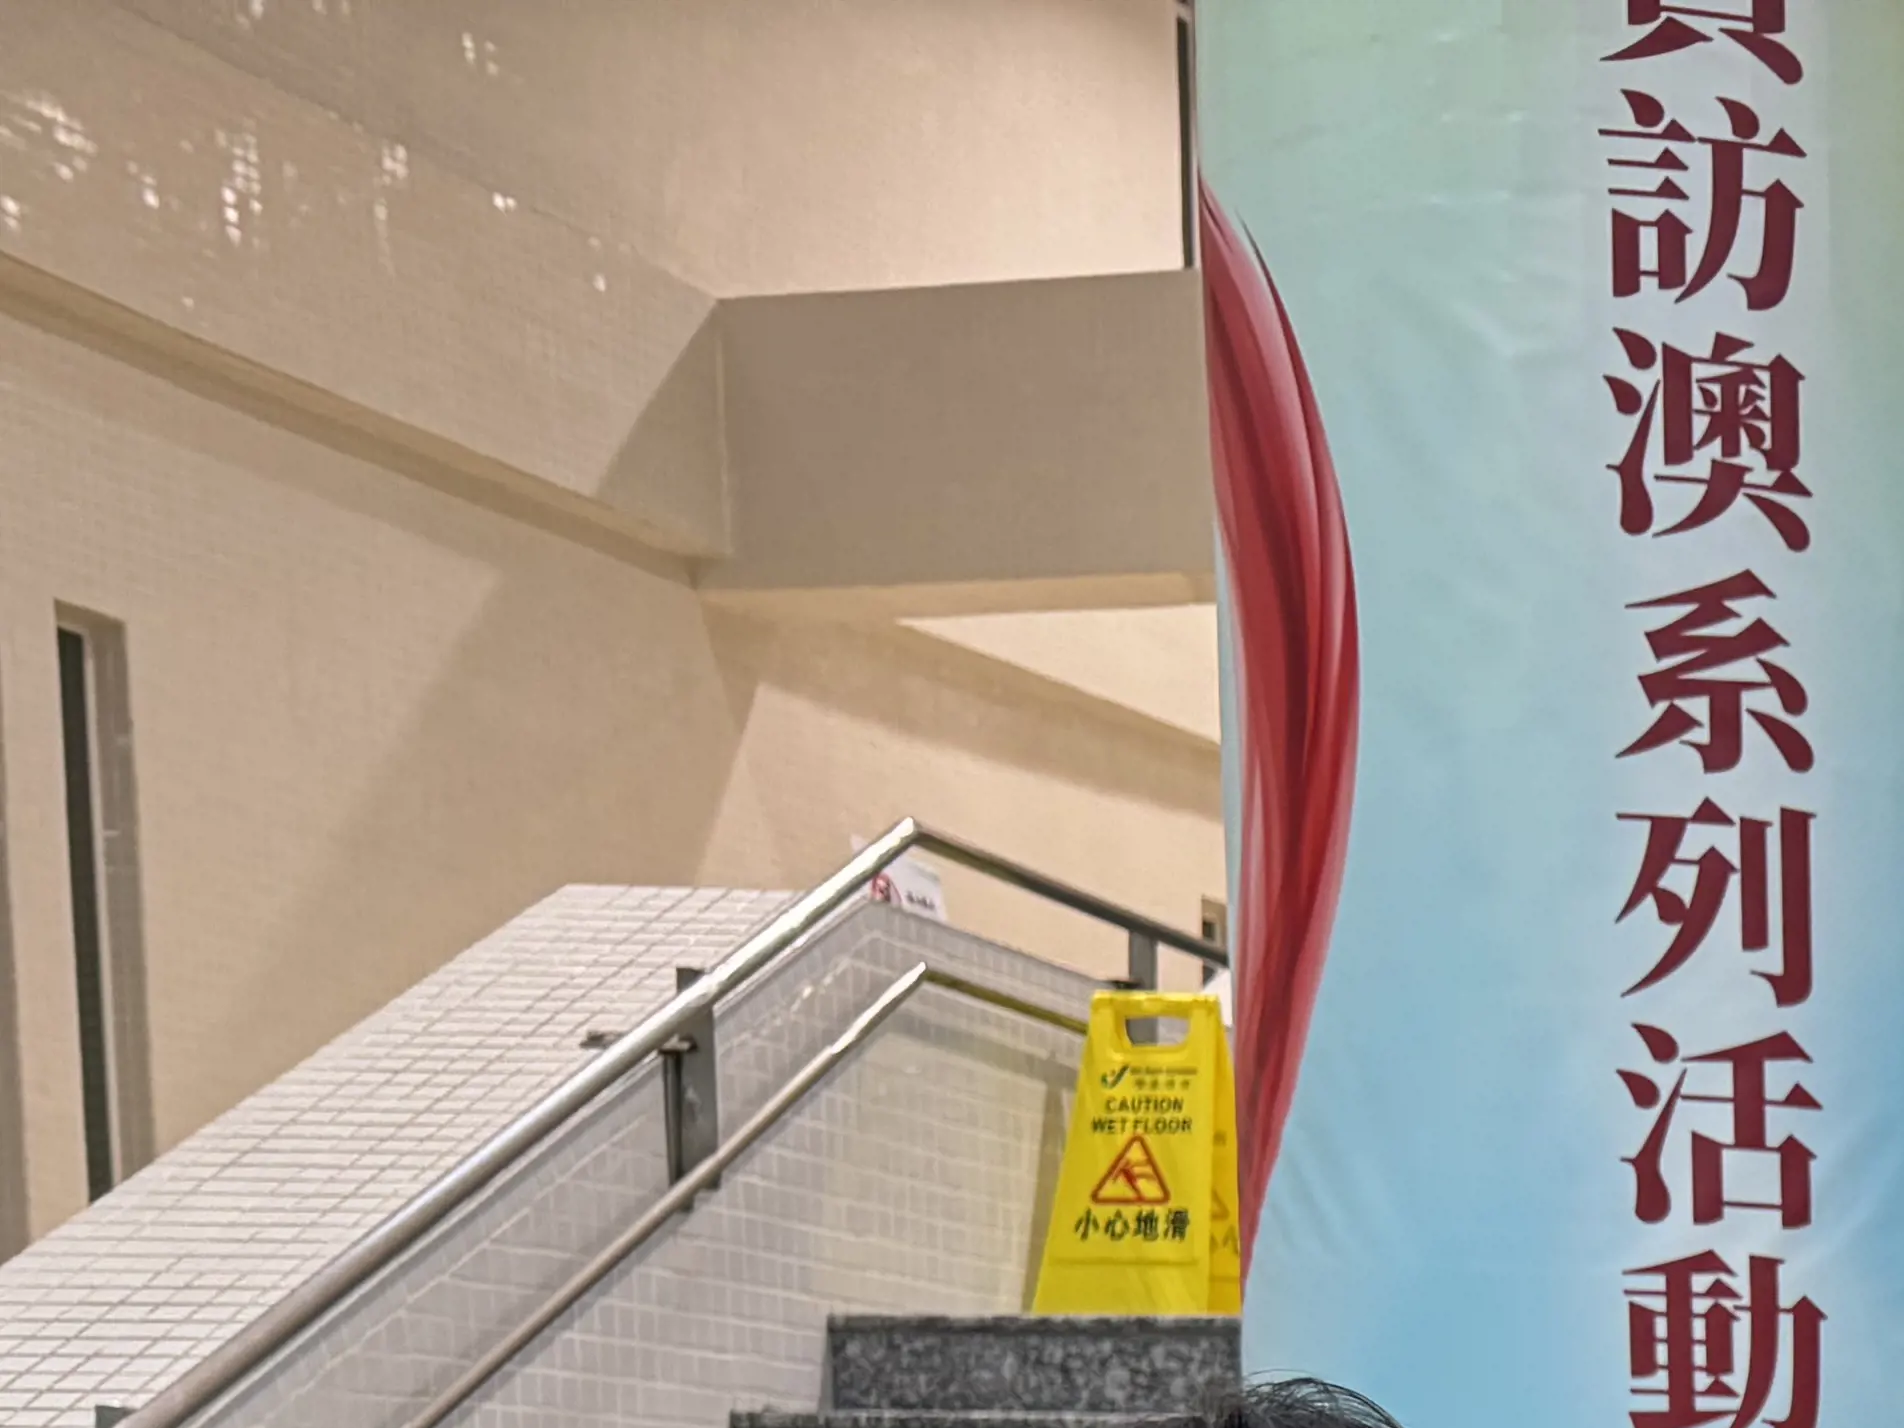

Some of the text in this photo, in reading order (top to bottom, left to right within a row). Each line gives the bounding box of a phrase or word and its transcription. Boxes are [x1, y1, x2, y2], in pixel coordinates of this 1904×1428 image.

[1105, 1095, 1184, 1113] CAUTION
[1091, 1116, 1193, 1135] WET FLOOR
[1075, 1206, 1190, 1243] 小心地滑
